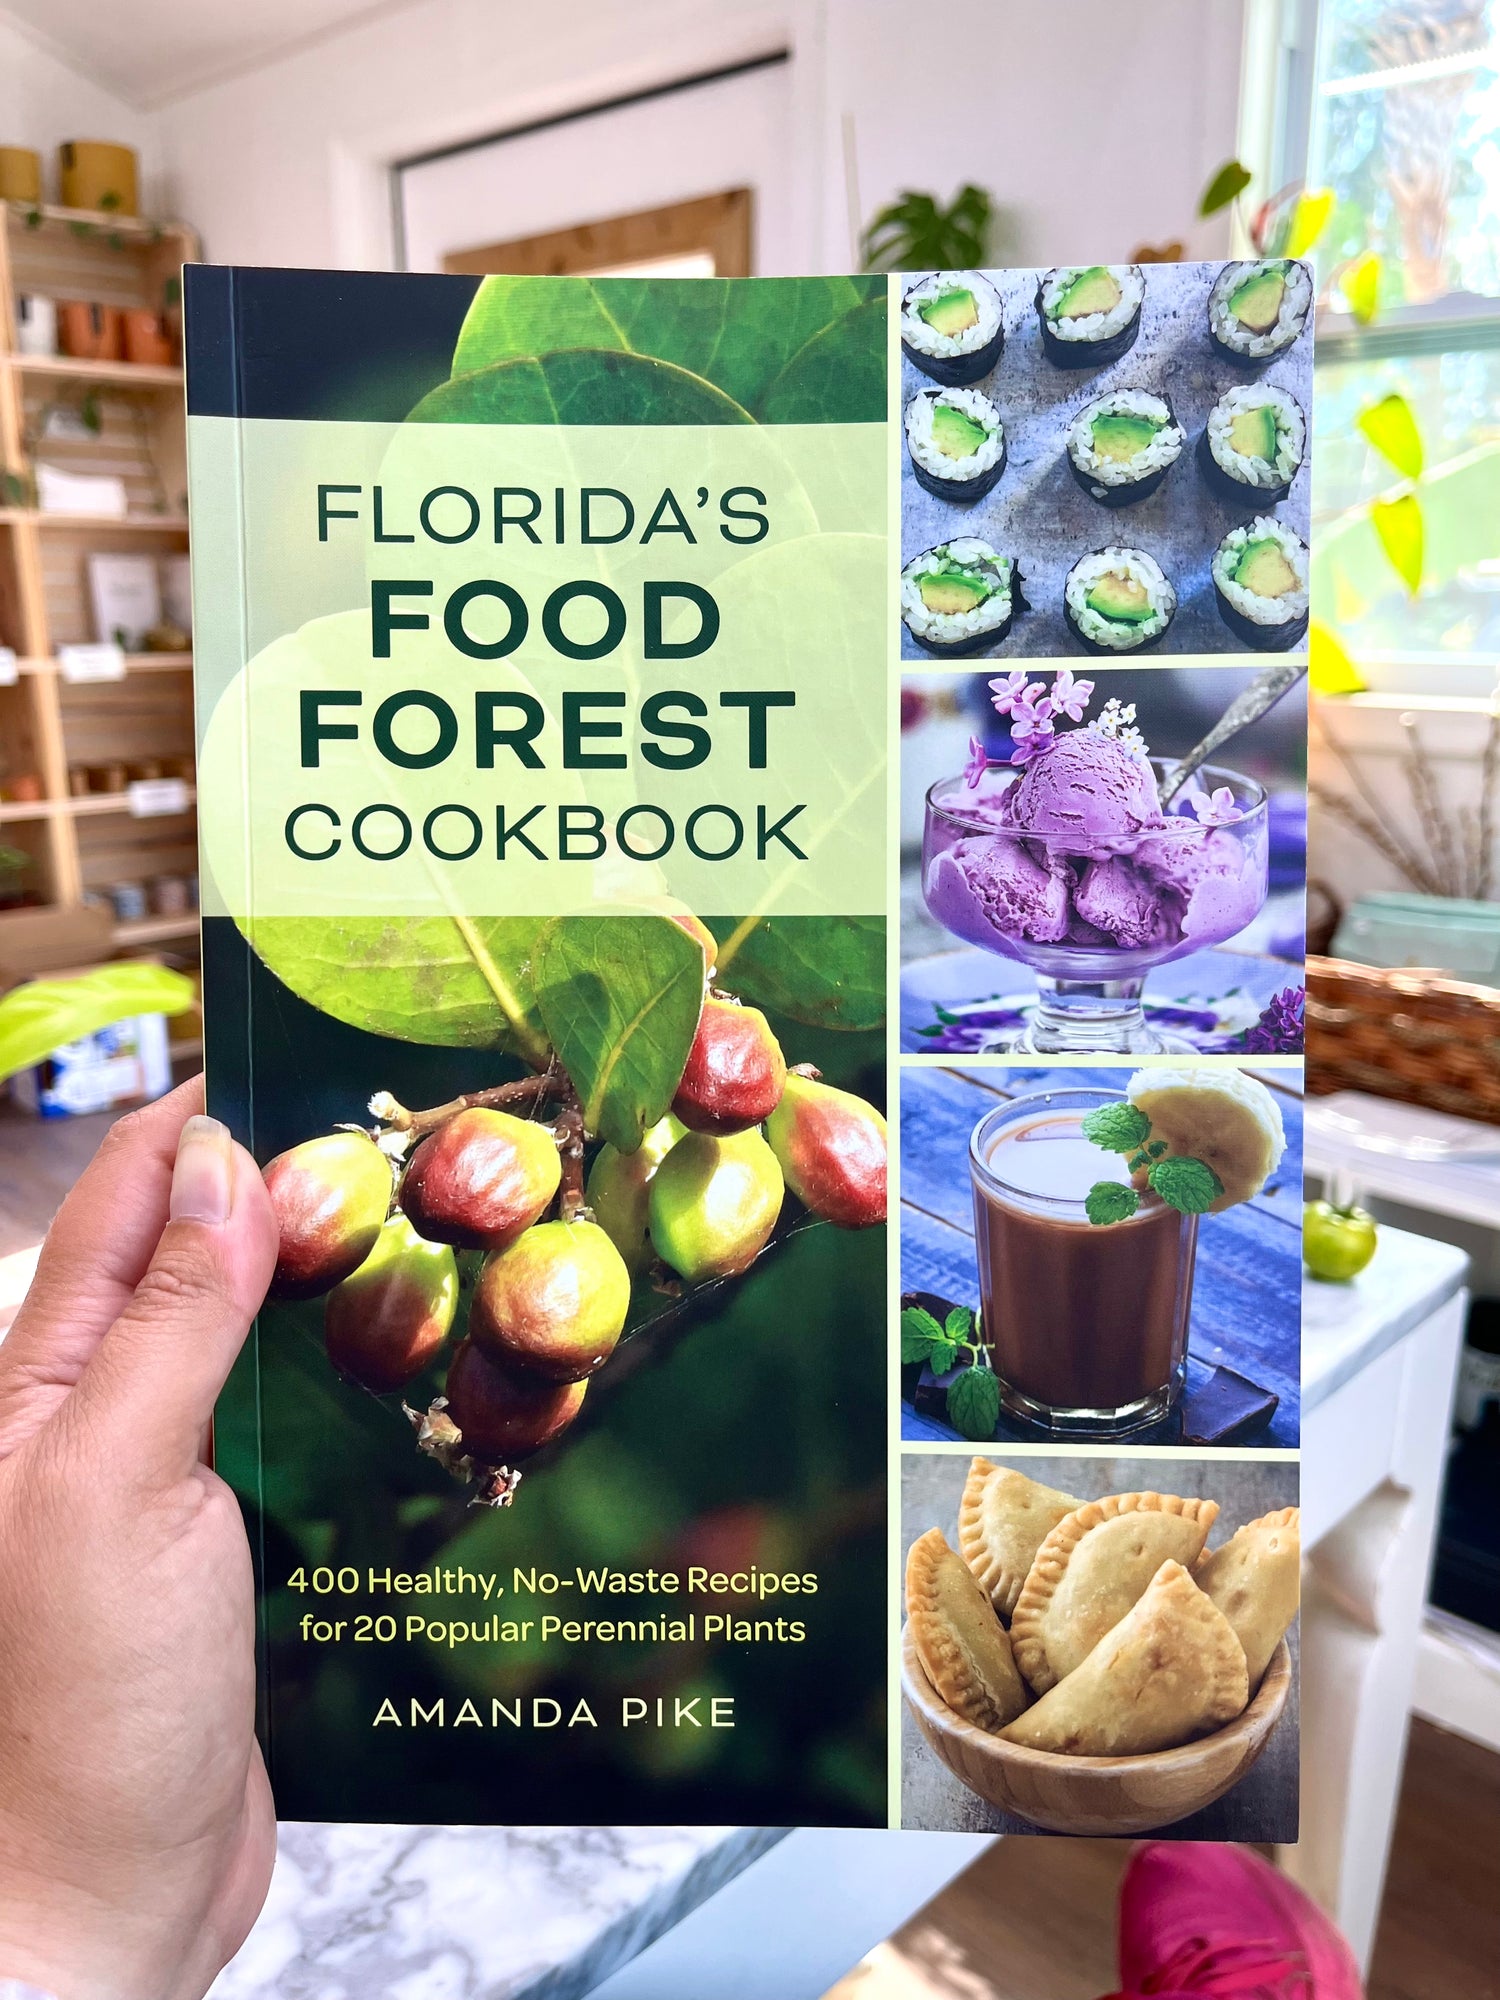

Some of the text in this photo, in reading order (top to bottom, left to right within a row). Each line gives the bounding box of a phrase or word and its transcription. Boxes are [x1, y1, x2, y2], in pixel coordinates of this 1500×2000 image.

[318, 484, 770, 544] FLORIDA’S
[371, 579, 720, 660] FOOD
[300, 690, 796, 770] FOREST
[284, 803, 809, 861] COOKBOOK
[287, 1566, 819, 1600] 400 Healthy, No-Waste Recipes
[300, 1613, 806, 1647] for 20 Popular Perennial Plants
[372, 1697, 736, 1727] AMANDA PIKE
